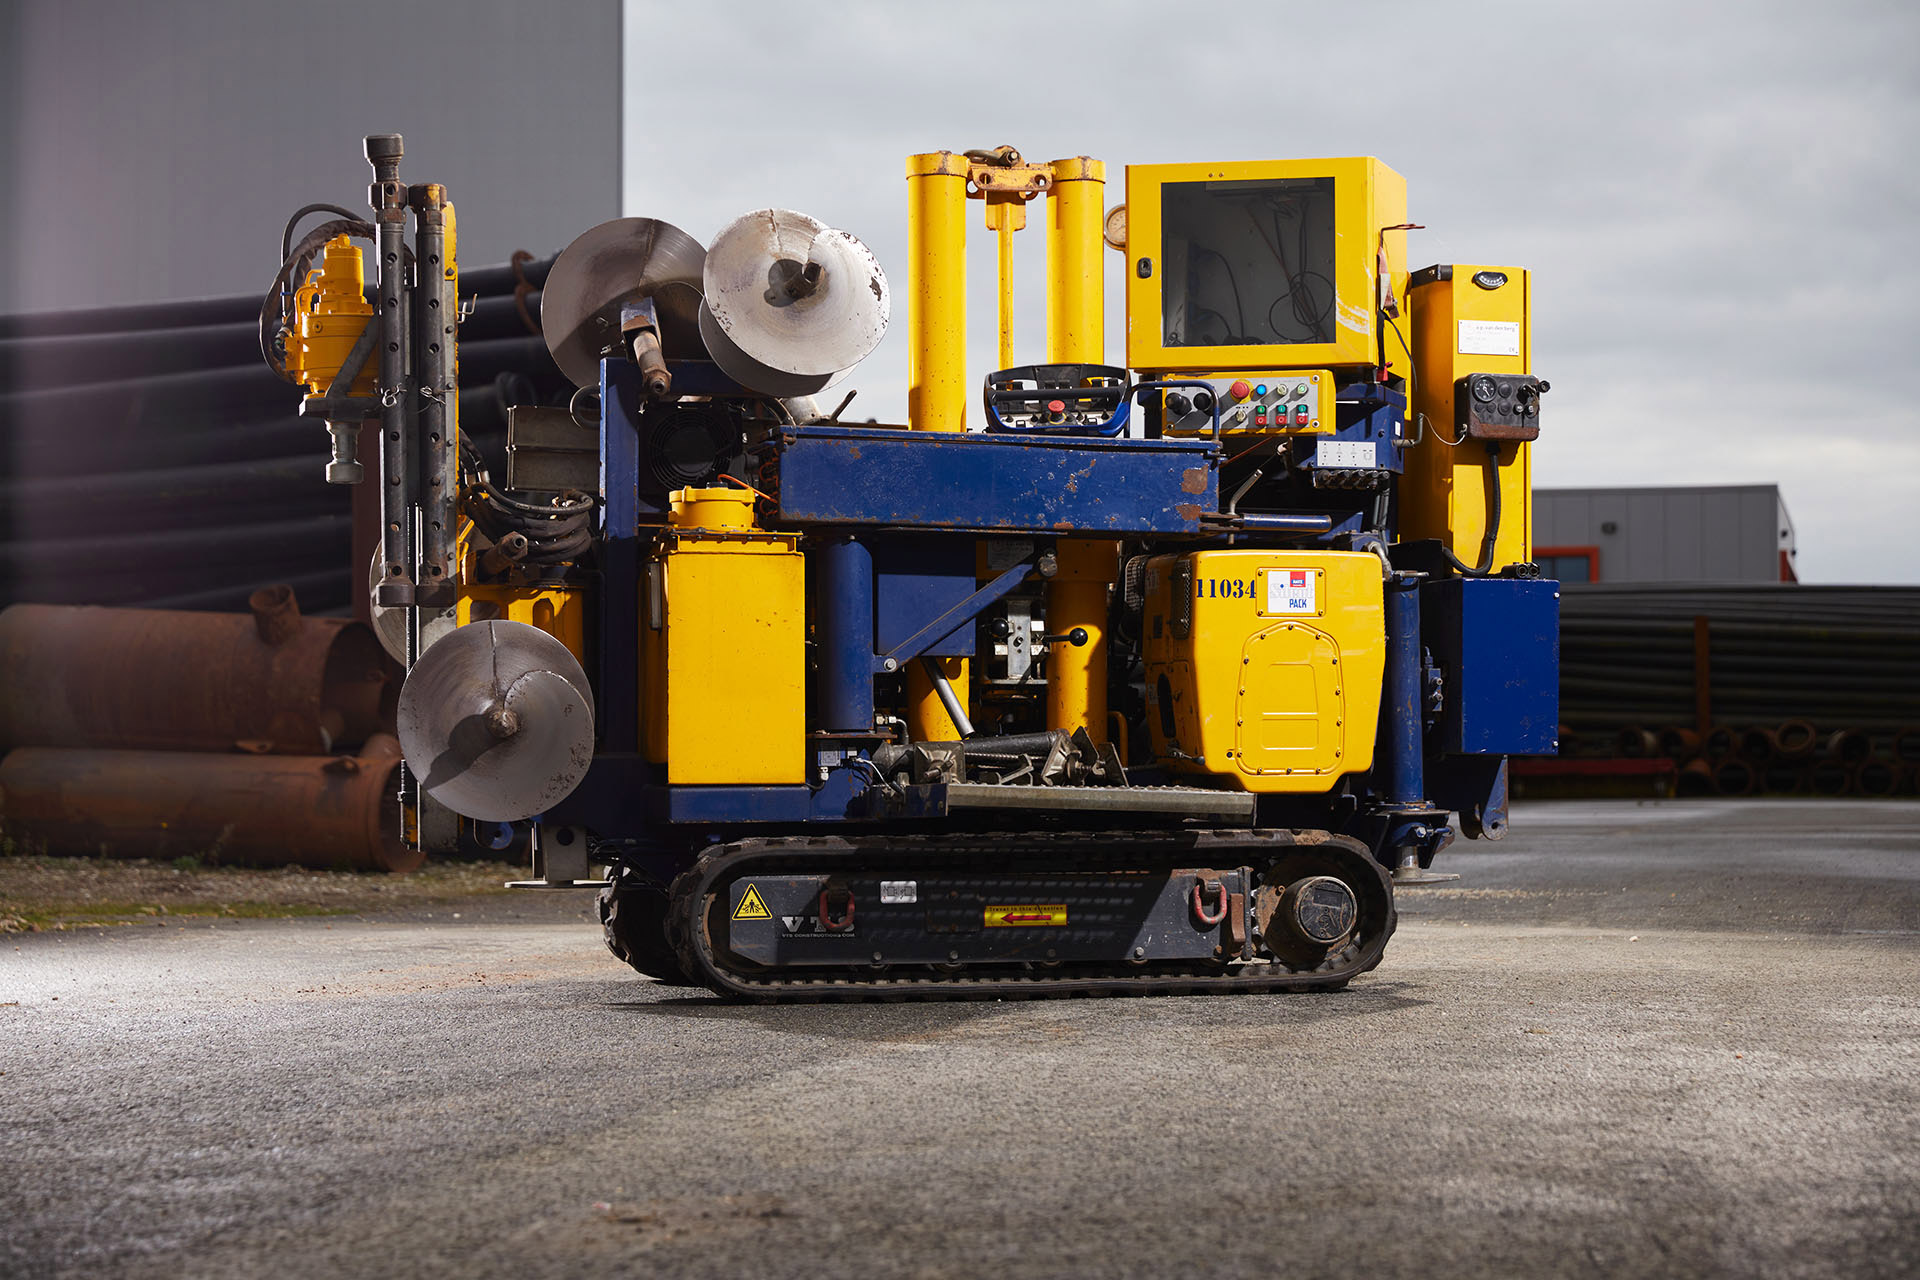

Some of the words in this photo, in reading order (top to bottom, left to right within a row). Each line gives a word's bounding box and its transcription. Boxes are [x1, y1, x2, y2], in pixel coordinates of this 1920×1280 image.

[1196, 578, 1257, 599] 11034
[1288, 598, 1308, 609] PACK
[781, 916, 855, 933] VT
